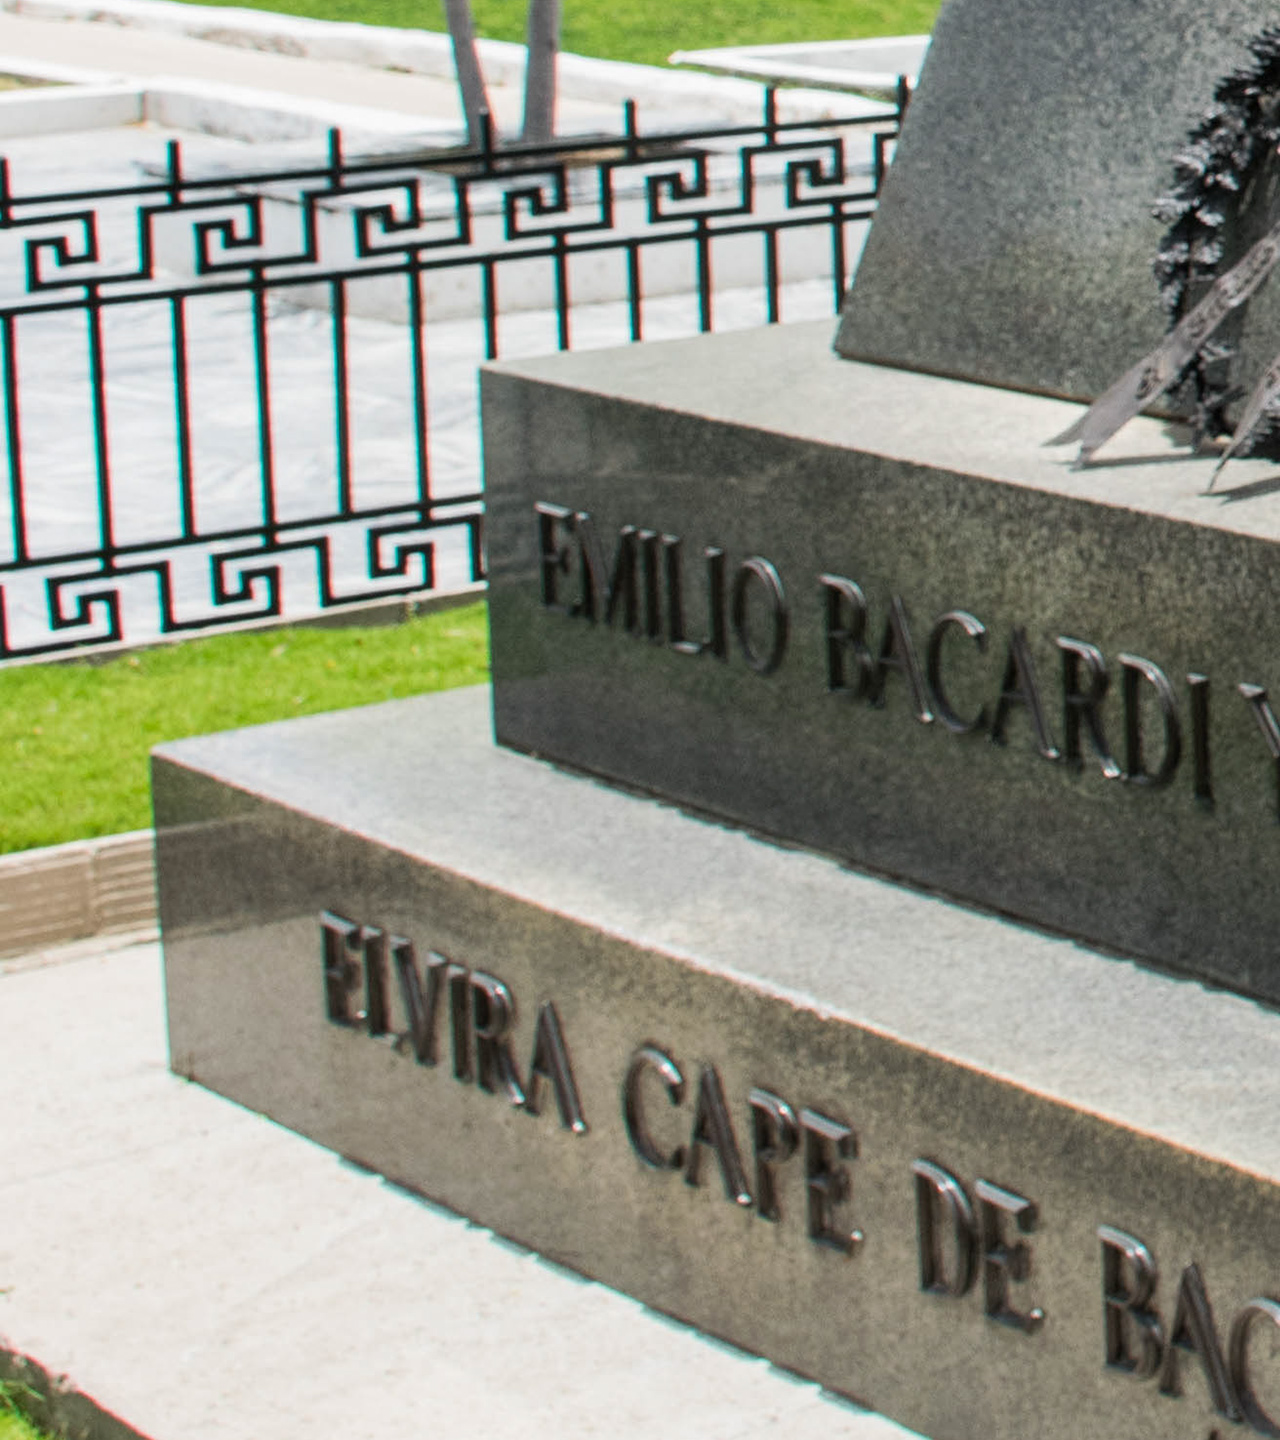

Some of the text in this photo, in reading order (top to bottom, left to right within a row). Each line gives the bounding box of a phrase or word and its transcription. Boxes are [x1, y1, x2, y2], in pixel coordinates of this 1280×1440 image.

[535, 501, 790, 674] EMILIO
[819, 575, 1215, 805] BACARDI
[321, 910, 588, 1134] ELVIRA
[622, 1042, 865, 1255] CAPE
[912, 1157, 1045, 1335] DE
